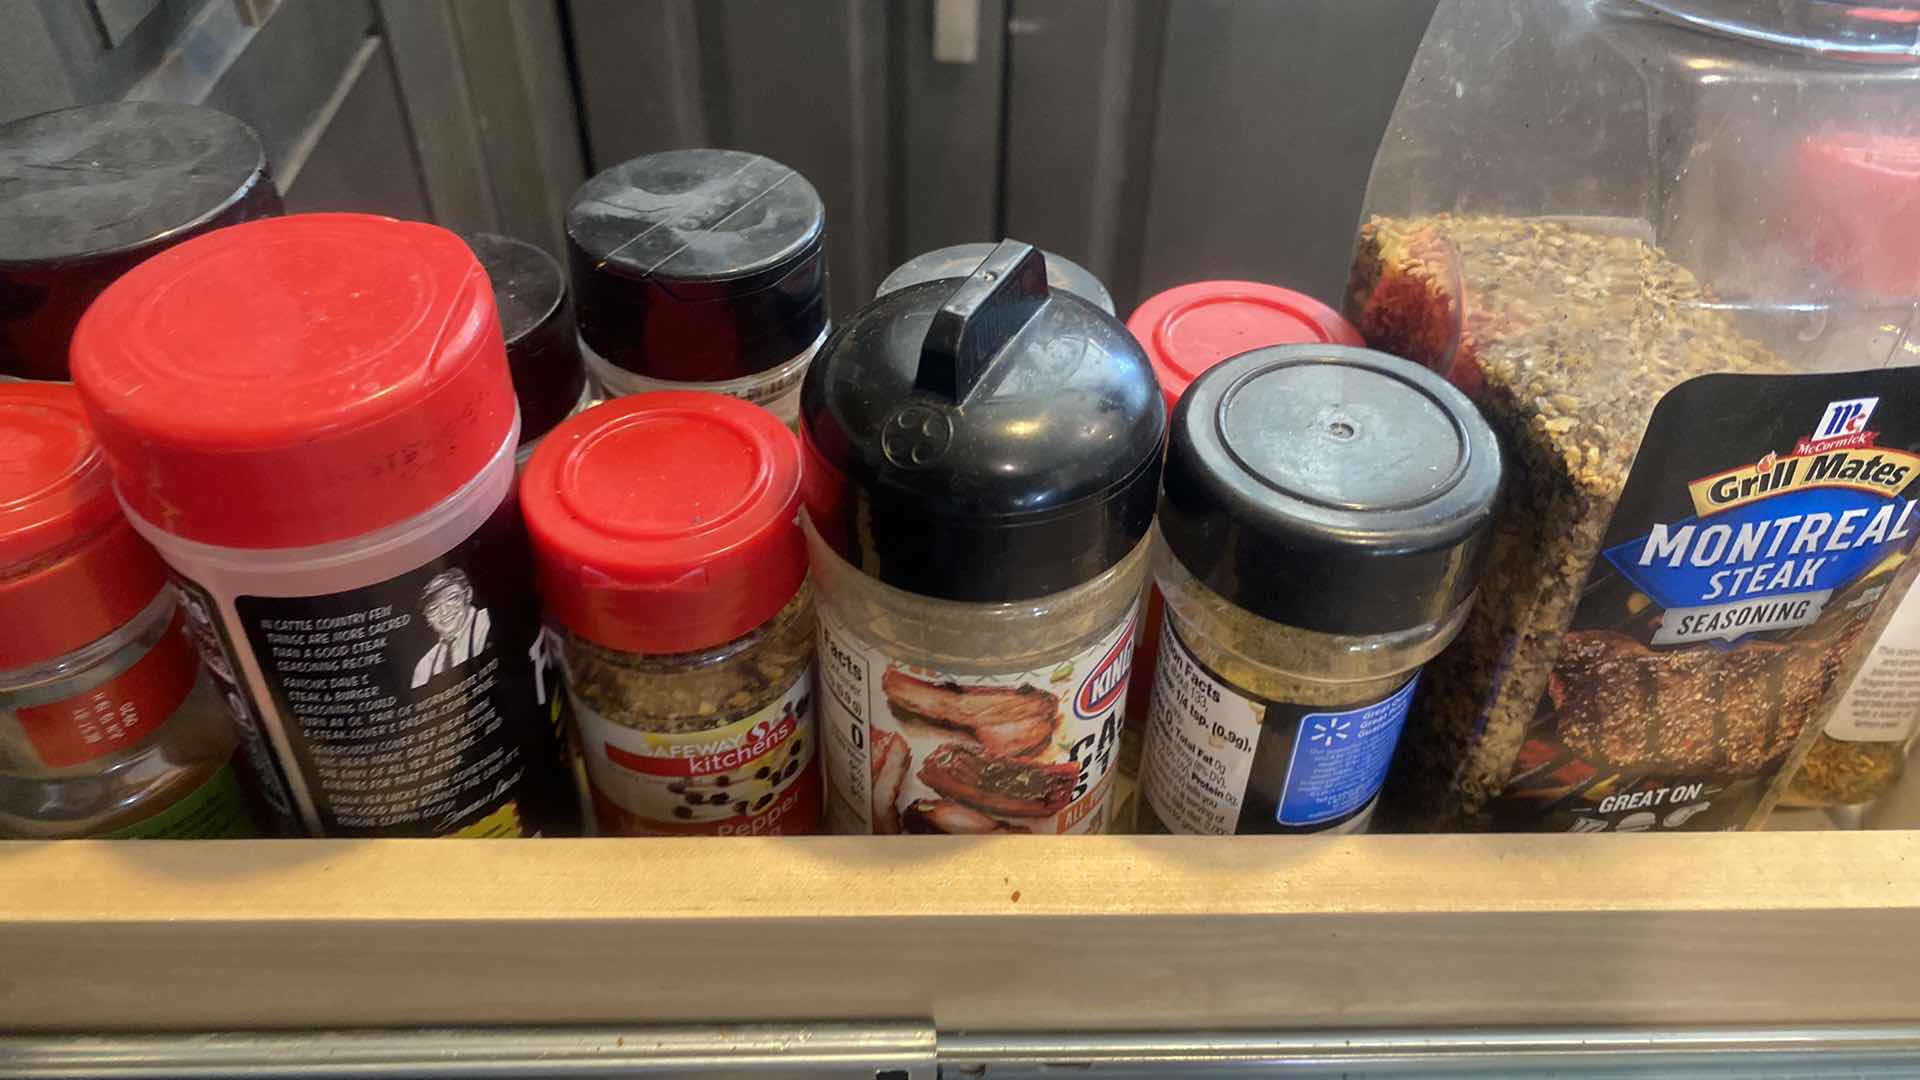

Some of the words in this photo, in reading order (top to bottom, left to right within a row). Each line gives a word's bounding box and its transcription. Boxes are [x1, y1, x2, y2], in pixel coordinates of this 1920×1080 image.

[1797, 433, 1868, 456] McCormick
[1708, 456, 1799, 505] Grill
[1804, 451, 1912, 487] Mates
[1638, 499, 1919, 568] MONTREAL
[1702, 557, 1827, 601] STEAK
[315, 612, 367, 630] COUNTRY
[1677, 599, 1811, 636] SEASONING
[308, 632, 331, 645] ARE
[332, 626, 366, 643] MORE
[313, 645, 350, 660] GOOD
[1184, 661, 1221, 703] Facts
[1190, 704, 1210, 729] tsp.
[689, 722, 789, 776] kitchens
[1196, 748, 1214, 766] Fat
[1191, 772, 1224, 799] Protein
[1598, 787, 1670, 814] GREAT
[1669, 783, 1703, 803] ON
